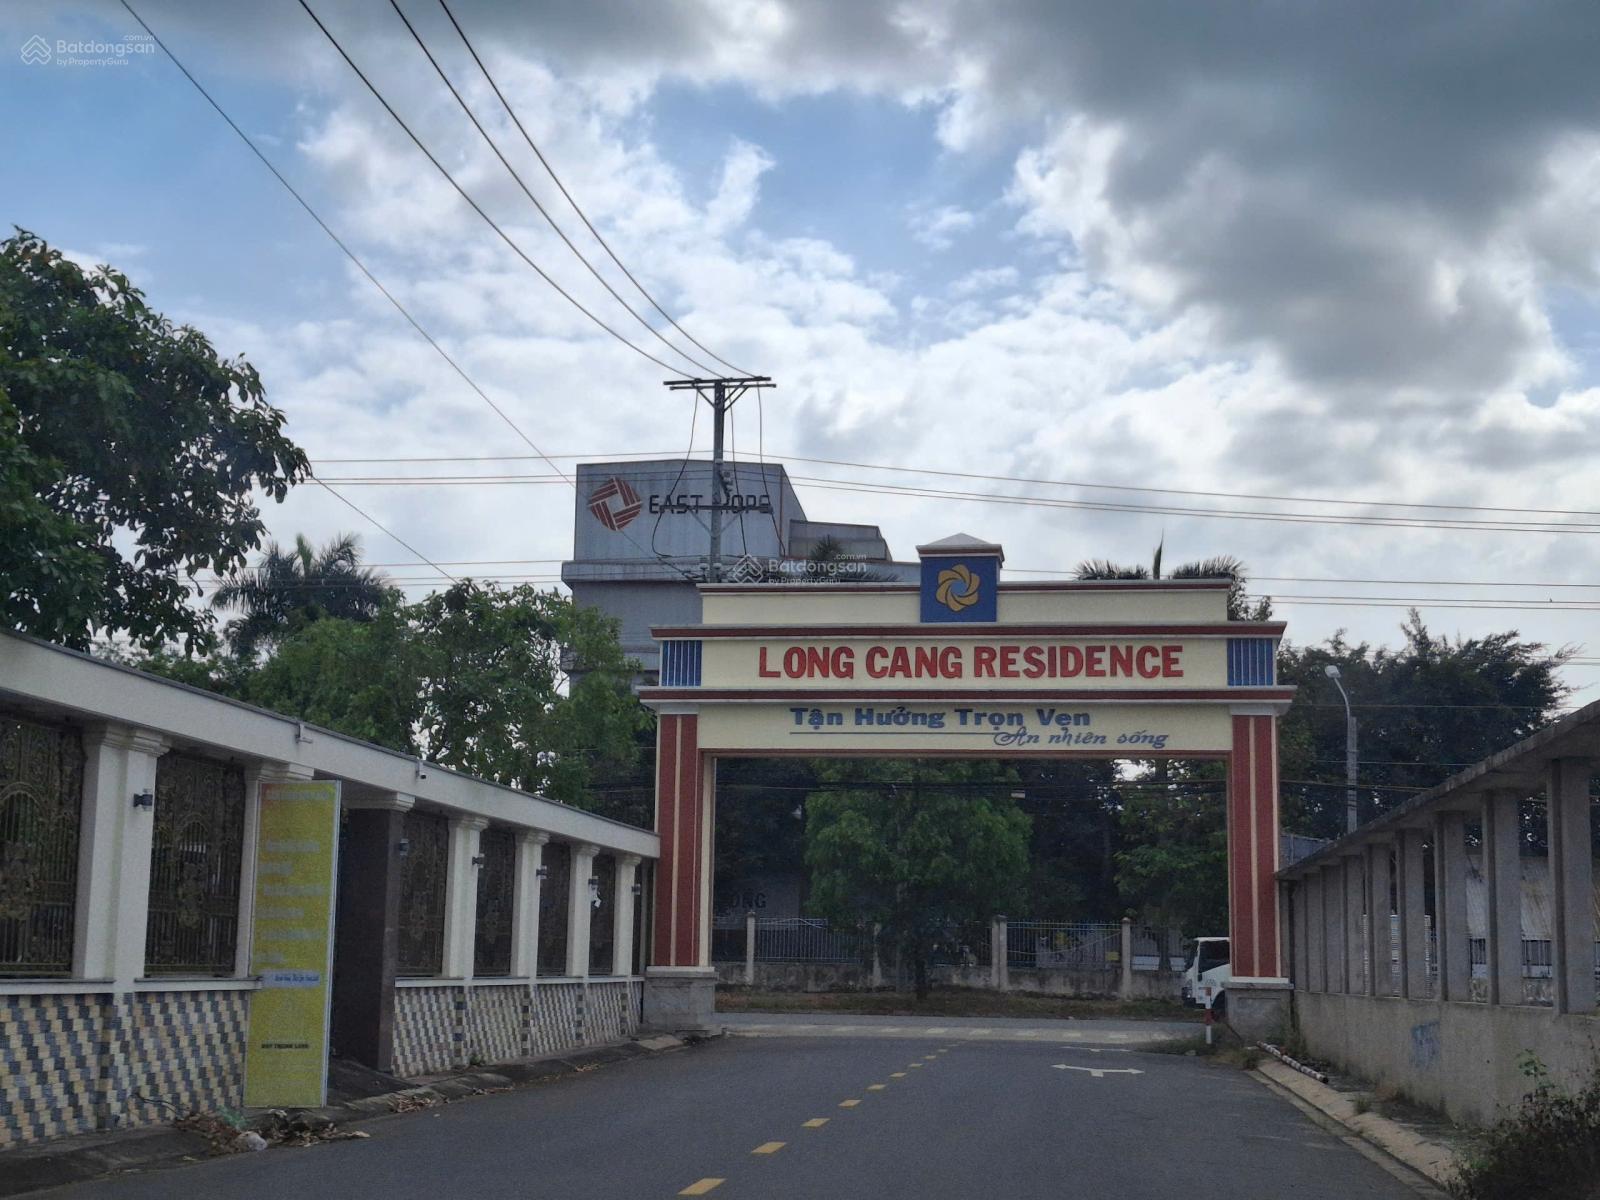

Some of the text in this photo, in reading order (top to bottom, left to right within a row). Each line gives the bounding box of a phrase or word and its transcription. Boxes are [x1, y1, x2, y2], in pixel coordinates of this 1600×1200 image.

[649, 494, 703, 514] EAST
[758, 644, 1184, 680] LONG CANG RESIDENCE
[789, 707, 843, 730] Tận
[854, 705, 946, 729] Hưởng
[954, 708, 1024, 731] Trọn
[1117, 729, 1169, 749] sống
